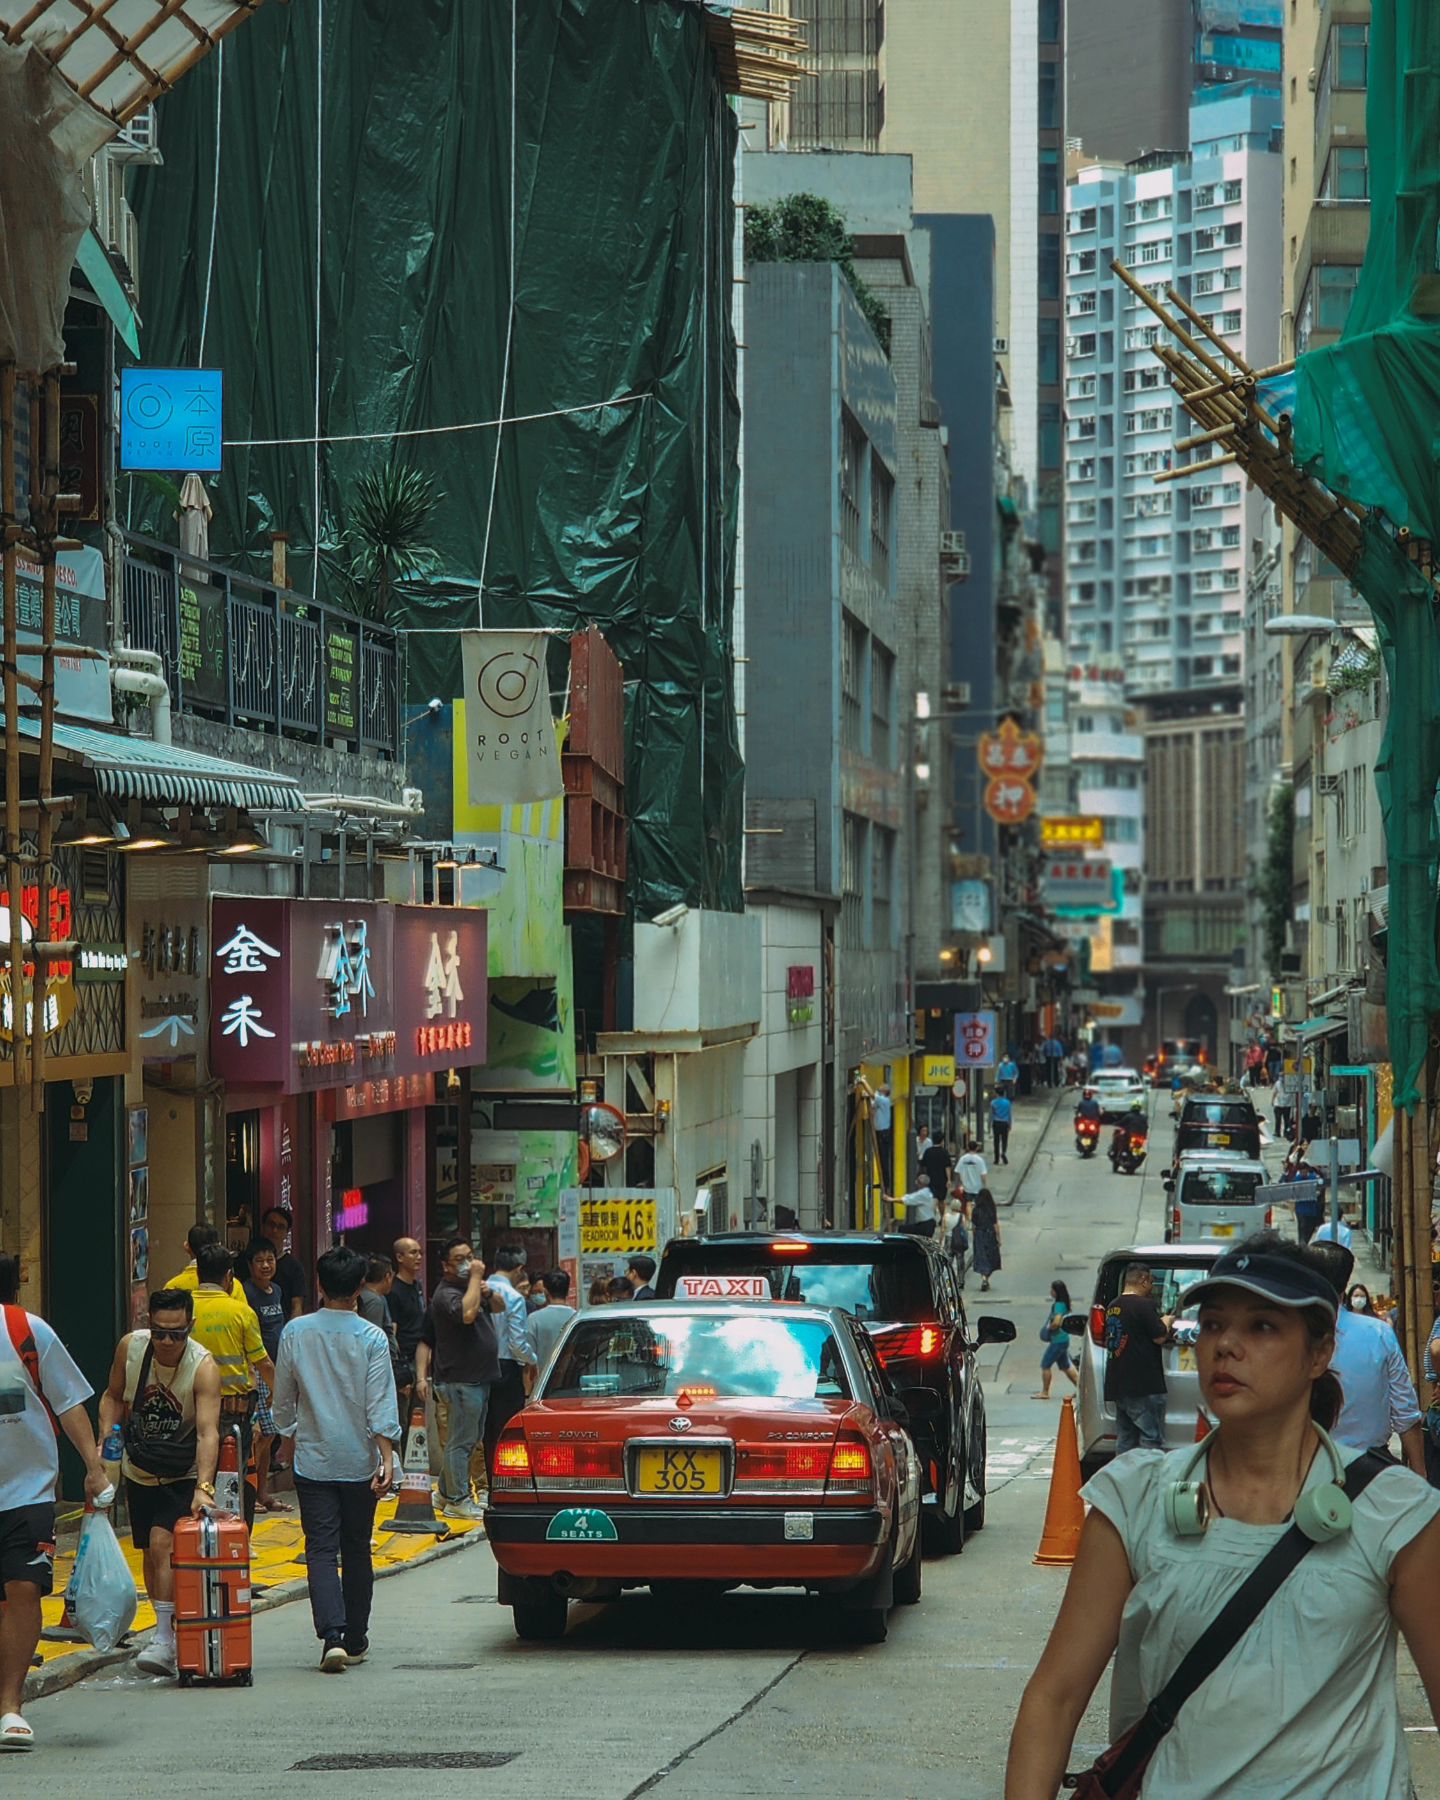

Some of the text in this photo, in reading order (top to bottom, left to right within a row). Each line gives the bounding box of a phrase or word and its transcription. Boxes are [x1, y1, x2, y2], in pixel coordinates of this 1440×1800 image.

[184, 384, 216, 456] 本原
[478, 730, 543, 747] ROOT
[477, 746, 547, 762] VEGAN
[622, 1209, 645, 1241] 4.6
[684, 1279, 764, 1296] TAXI
[664, 1449, 697, 1470] KX
[654, 1470, 706, 1490] 305
[574, 1516, 588, 1529] 4
[561, 1530, 603, 1538] SEATS
